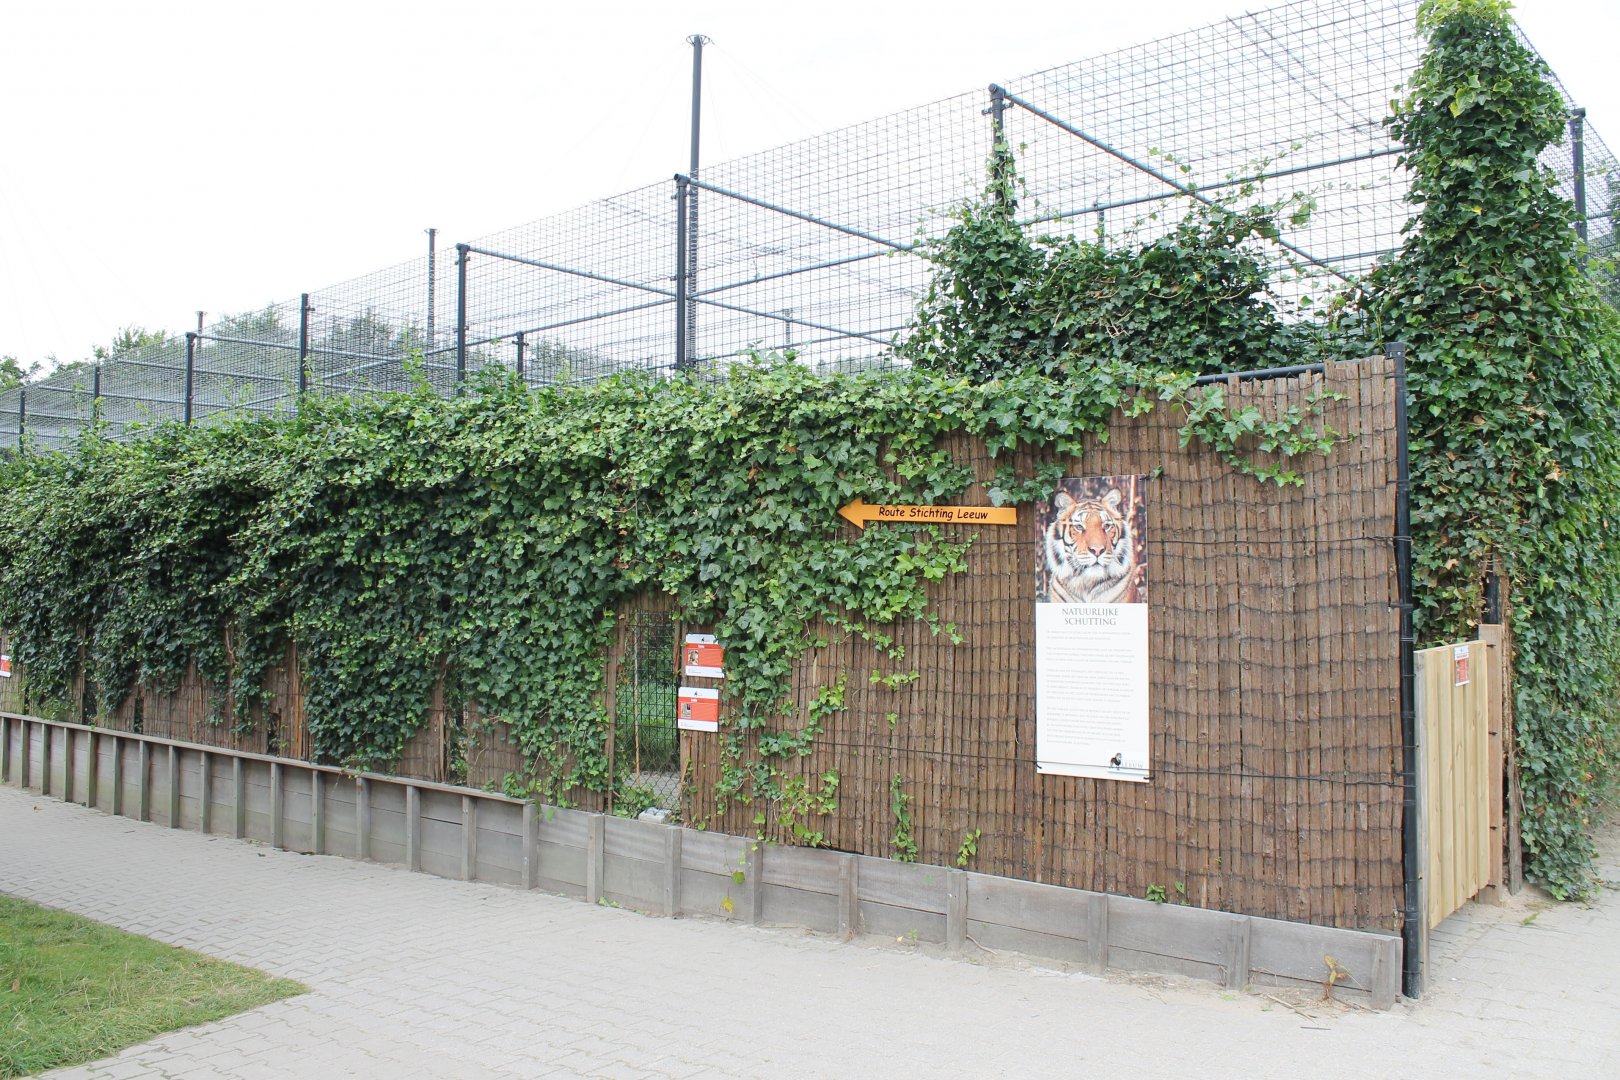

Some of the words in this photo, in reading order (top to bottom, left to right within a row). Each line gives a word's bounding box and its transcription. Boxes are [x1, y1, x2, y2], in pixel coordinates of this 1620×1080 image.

[879, 506, 905, 517] Route
[909, 507, 954, 521] Stichting
[957, 509, 988, 520] Leeuw
[1062, 608, 1119, 617] NATUURLIJKE
[1064, 617, 1117, 626] SCHUTTING
